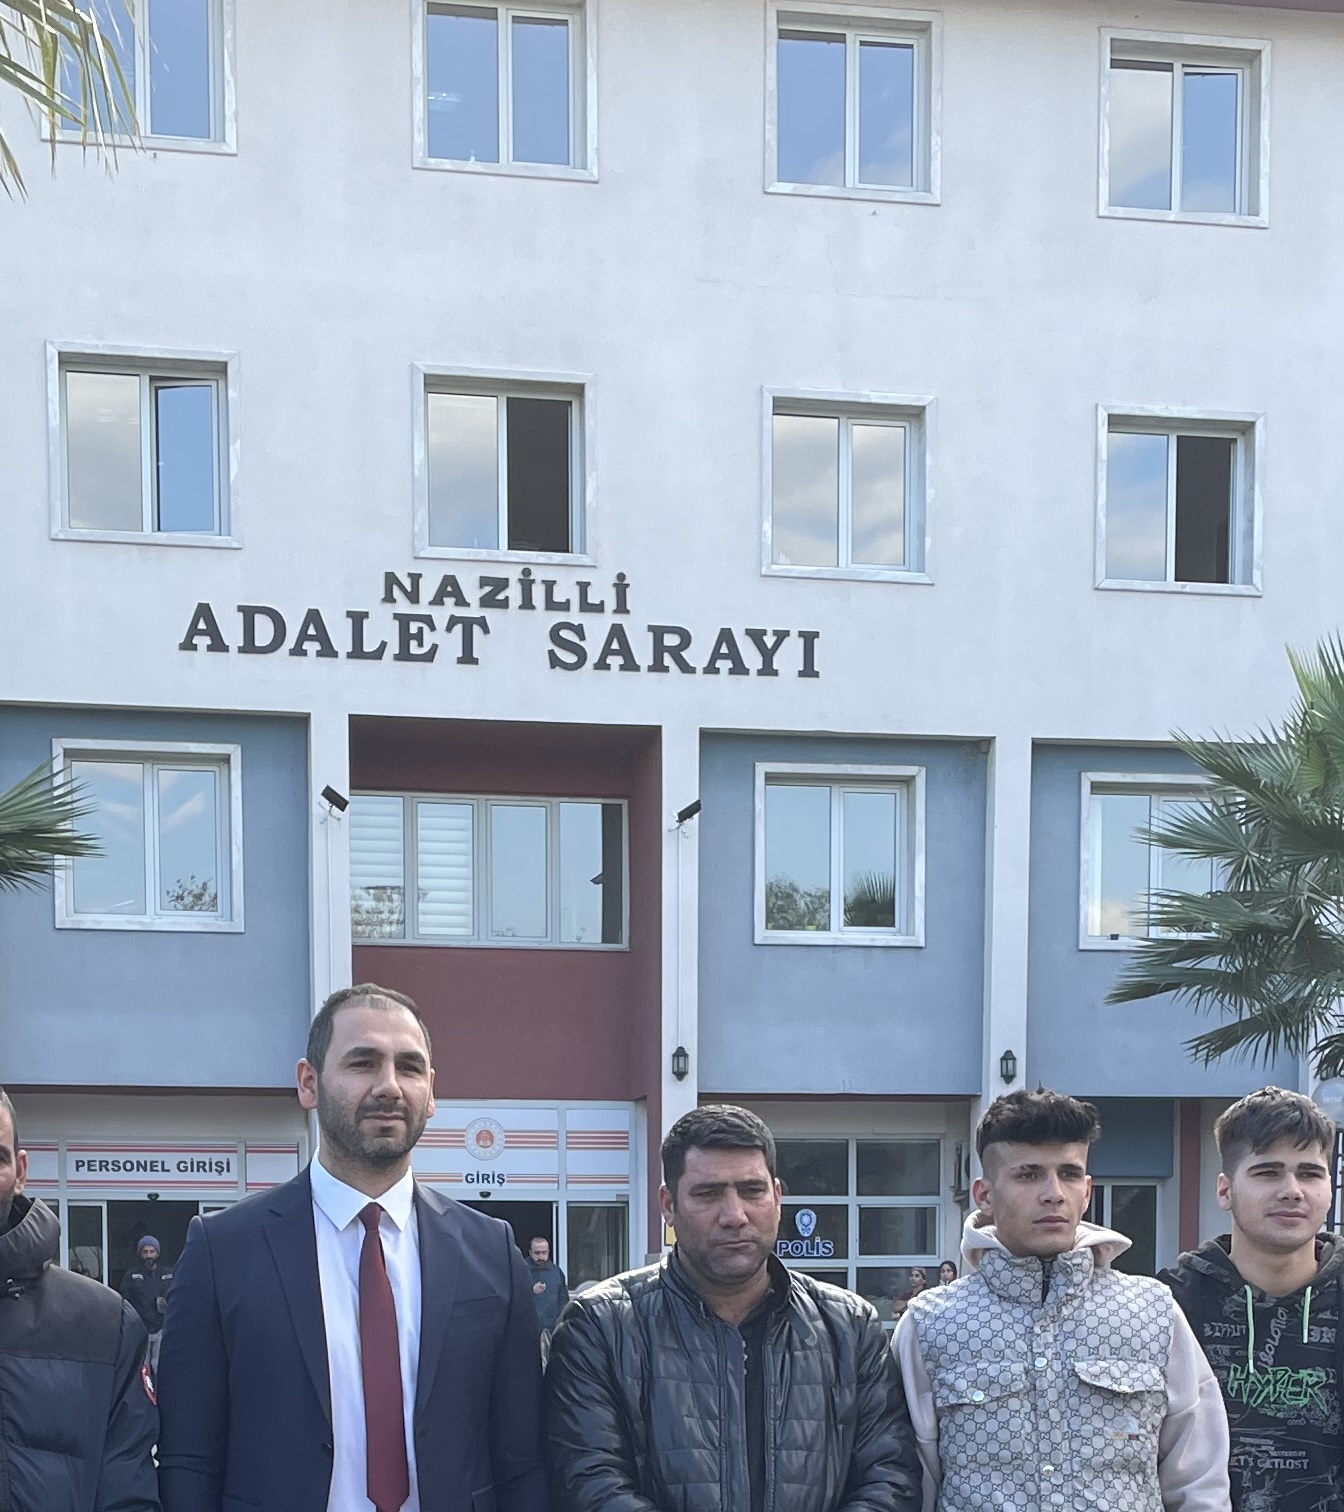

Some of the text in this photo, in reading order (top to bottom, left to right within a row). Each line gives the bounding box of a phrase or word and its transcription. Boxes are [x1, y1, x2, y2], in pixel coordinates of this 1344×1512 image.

[381, 567, 631, 615] NAZİLLİ
[179, 602, 821, 679] ADALET SARAYI
[74, 1158, 231, 1177] PERSONEL GİRİŞİ
[464, 1170, 506, 1188] GİRİŞ
[776, 1236, 834, 1257] POLİS
[1226, 1363, 1331, 1416] HYPER
